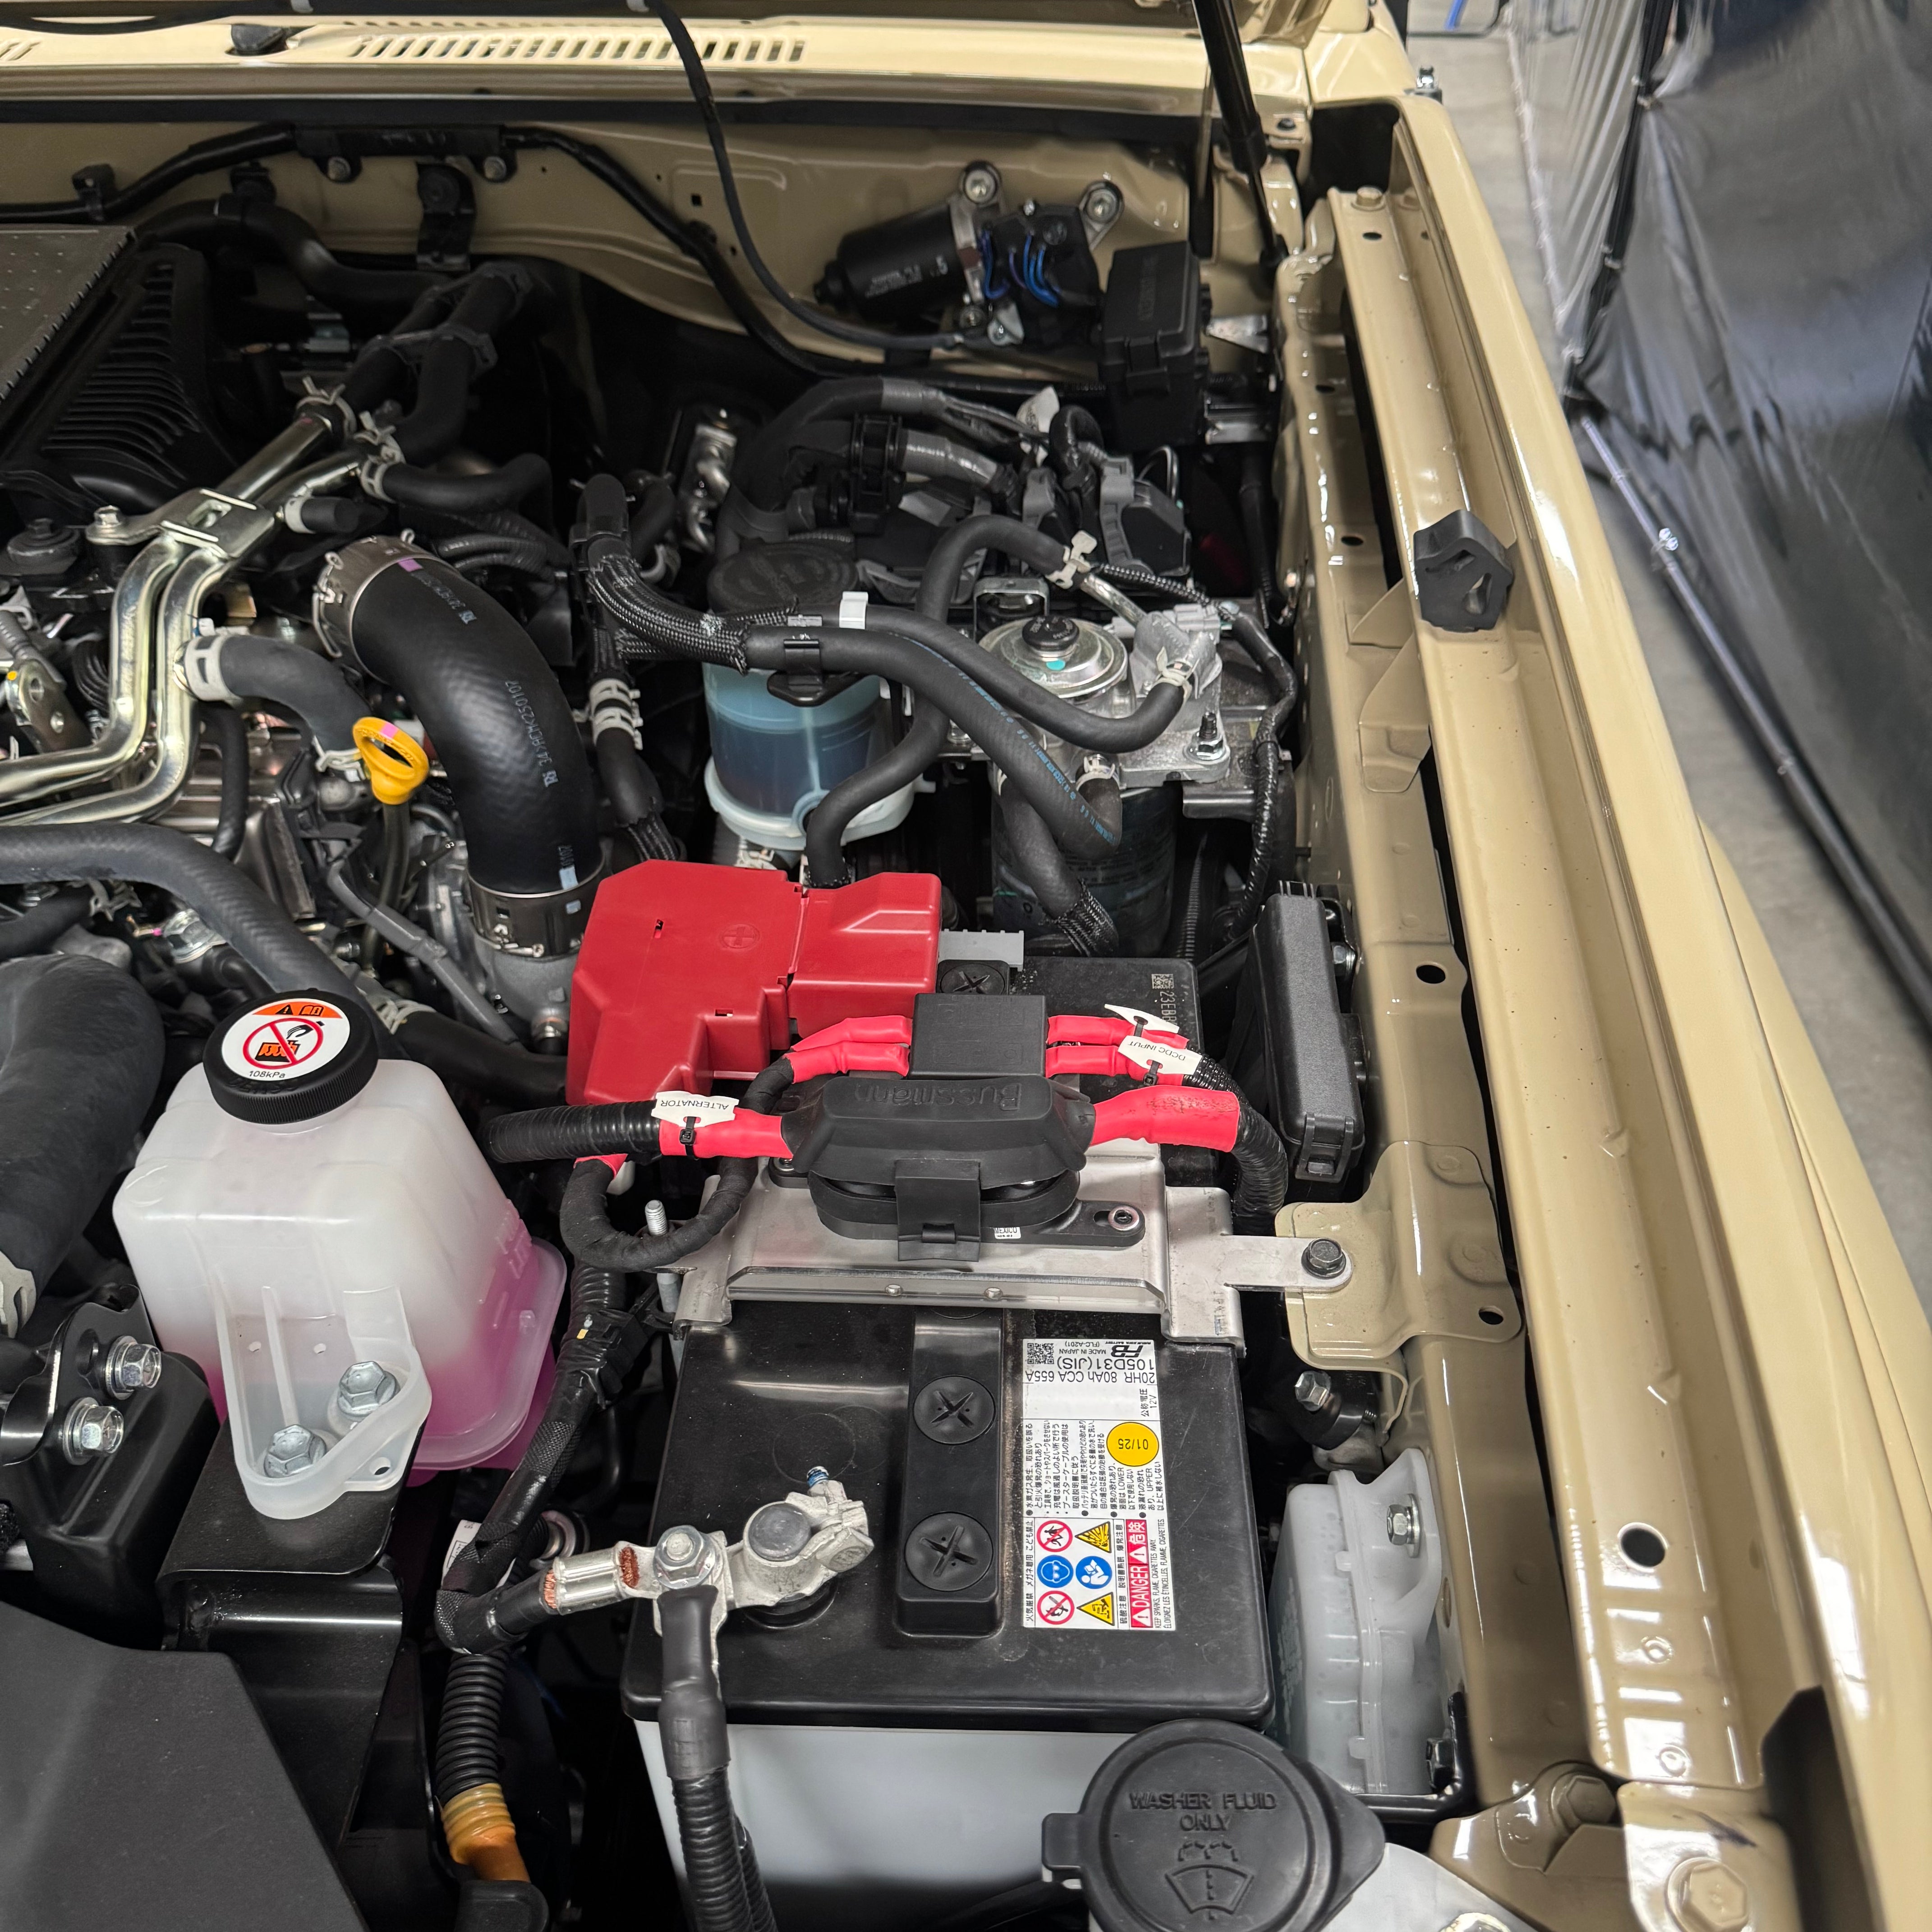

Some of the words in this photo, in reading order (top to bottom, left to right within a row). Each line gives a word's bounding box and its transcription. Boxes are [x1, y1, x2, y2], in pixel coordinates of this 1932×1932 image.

[1160, 991, 1177, 1025] 23EBB
[1128, 1041, 1156, 1051] INPUT
[1159, 1047, 1186, 1061] DCDC
[854, 1083, 1022, 1111] Bussmann
[661, 1100, 729, 1110] ALTERNATOR
[1057, 1357, 1155, 1370] 105D31(JIS)
[1026, 1371, 1054, 1382] 655A
[1058, 1371, 1084, 1382] CCA
[1088, 1371, 1117, 1382] 80Ah
[1124, 1372, 1155, 1383] 20HR
[1118, 1439, 1148, 1449] 01/25
[1129, 1522, 1145, 1545] 危険
[1130, 1566, 1150, 1607] DANGER
[1130, 1792, 1211, 1809] WASHER
[1223, 1793, 1277, 1809] FLUID
[1181, 1814, 1232, 1831] ONLY
